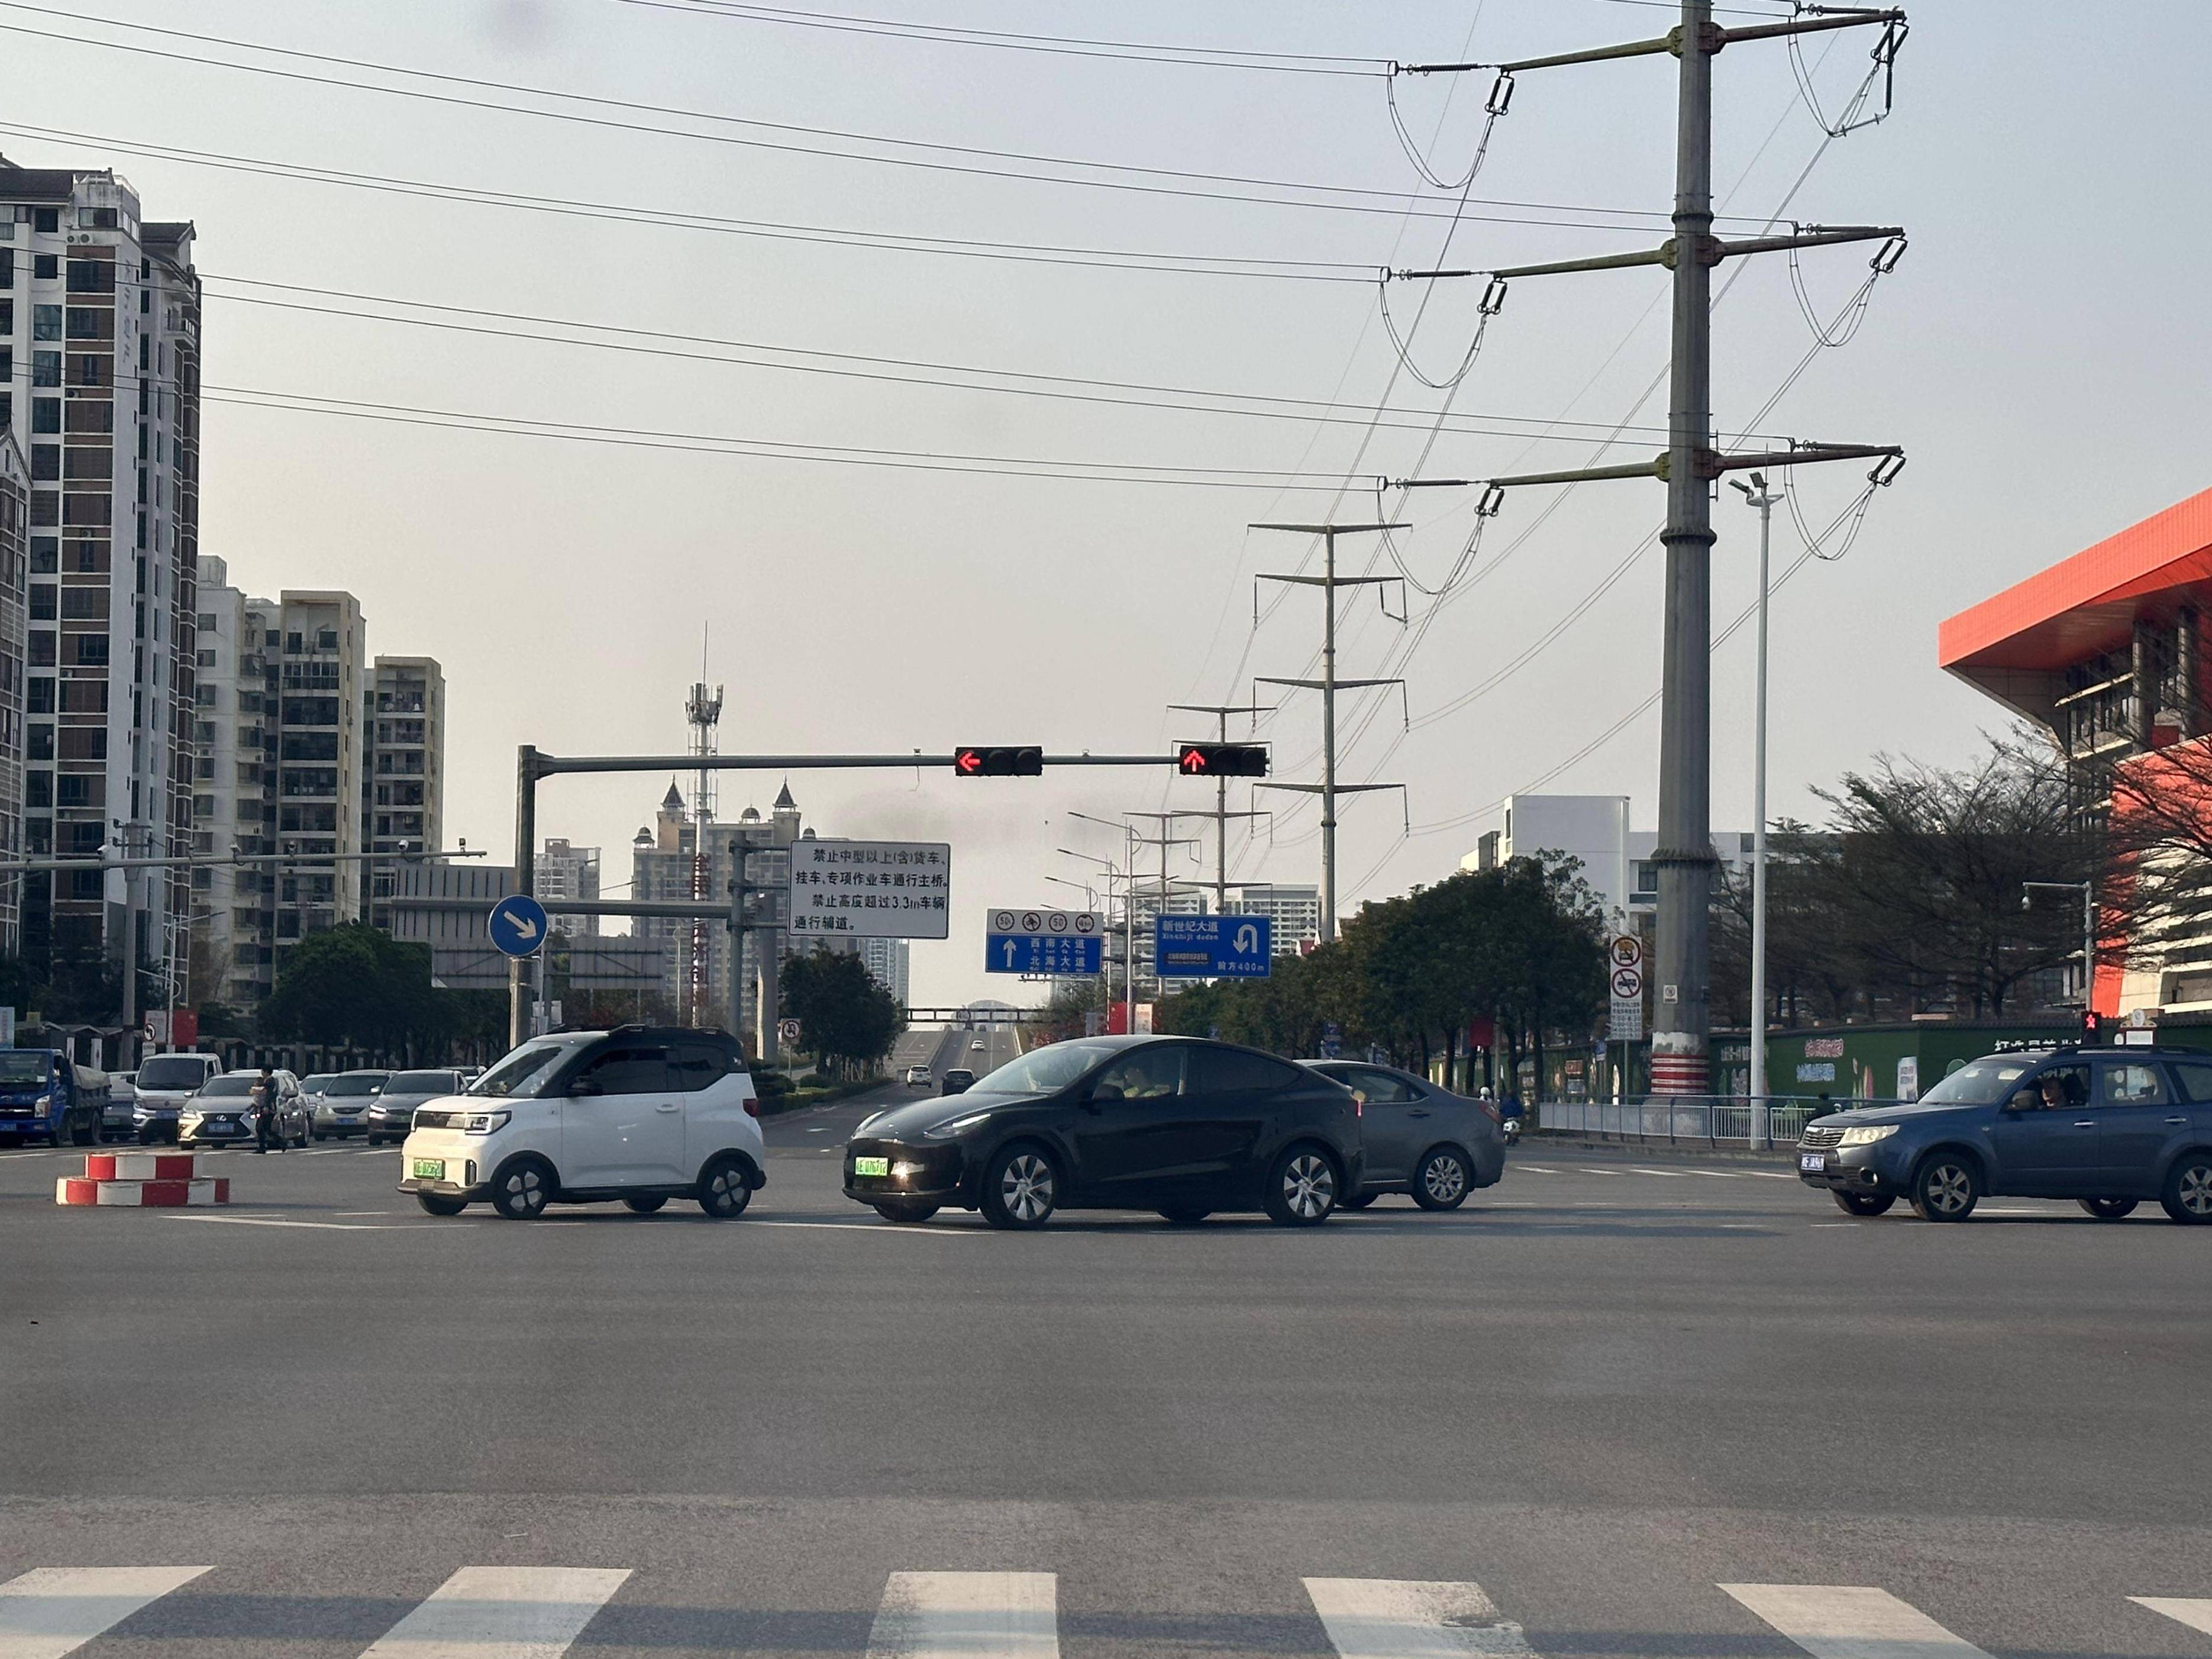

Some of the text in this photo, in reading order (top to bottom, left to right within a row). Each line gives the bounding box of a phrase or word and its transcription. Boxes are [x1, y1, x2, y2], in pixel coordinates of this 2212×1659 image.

[1162, 921, 1219, 932] 新世纪大道
